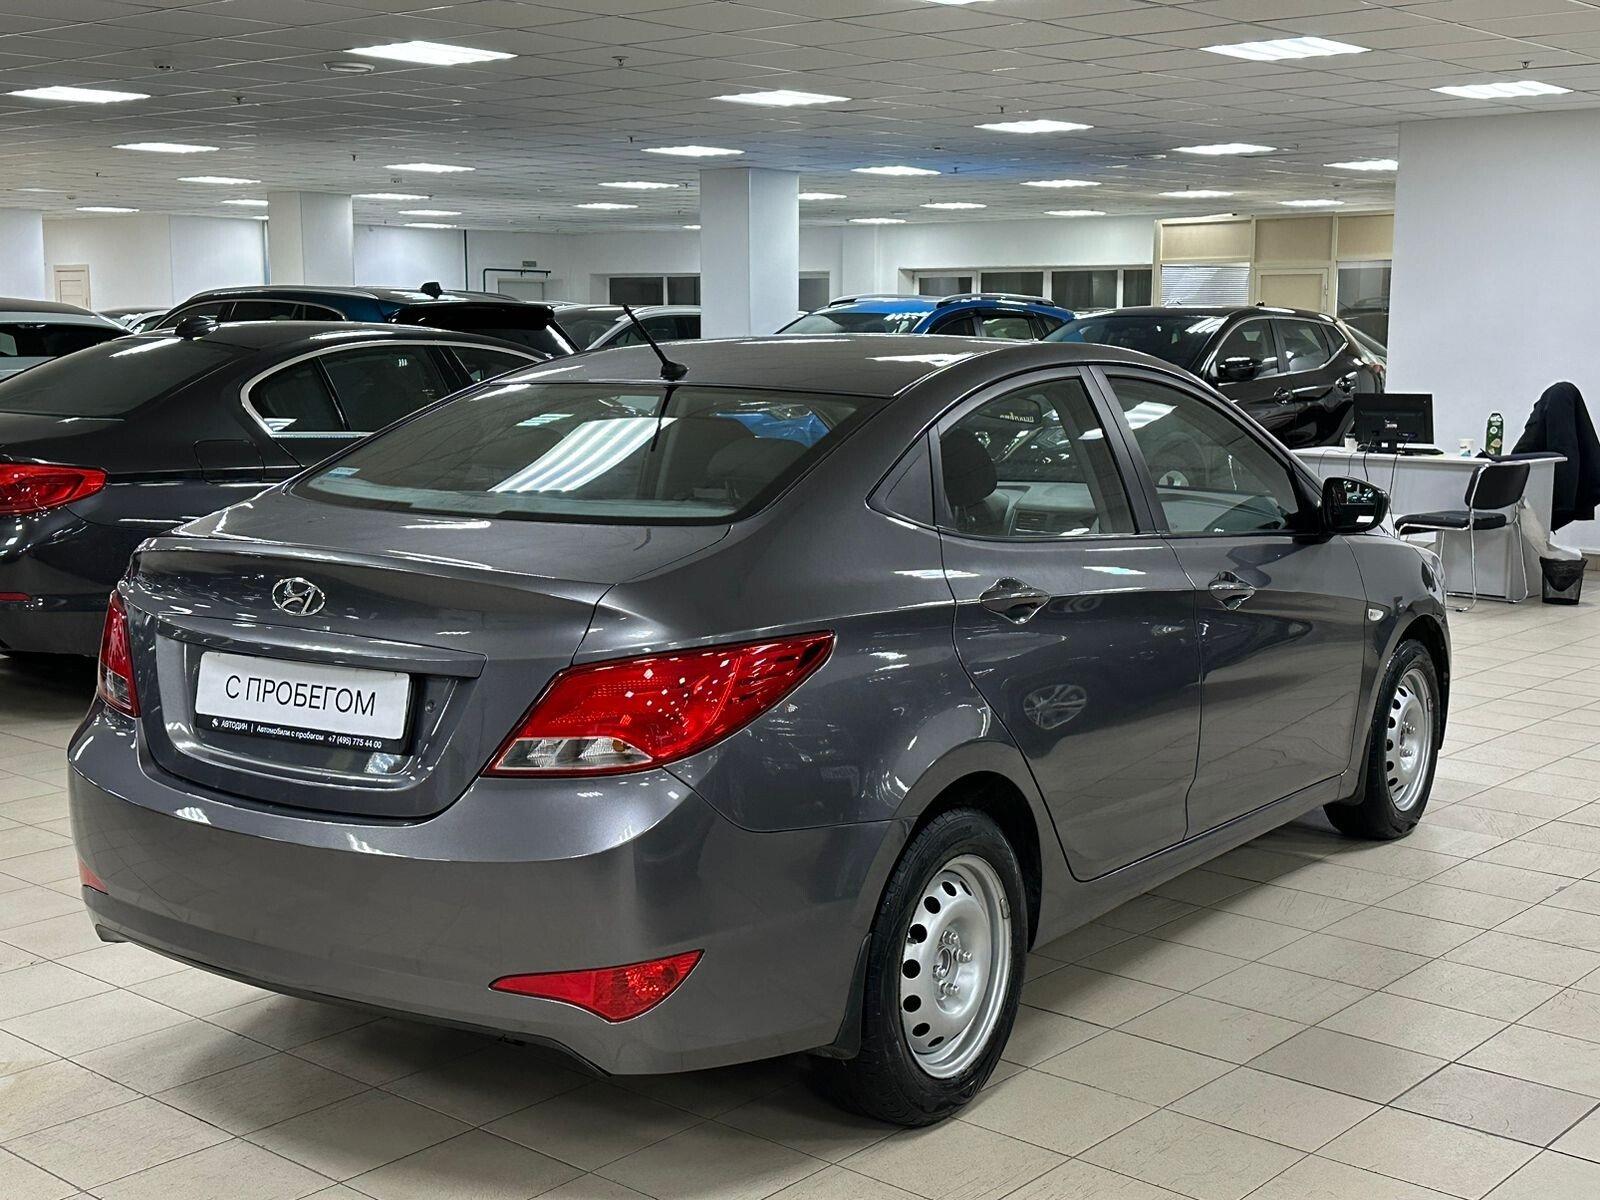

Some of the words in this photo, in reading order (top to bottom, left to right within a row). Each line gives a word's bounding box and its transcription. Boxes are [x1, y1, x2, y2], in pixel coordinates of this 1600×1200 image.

[226, 675, 241, 699] С
[245, 677, 376, 717] ПРОБЕГОМ
[220, 719, 248, 731] АВТОДИН
[256, 725, 291, 737] Автомобили
[295, 731, 324, 741] пробегом
[327, 735, 337, 743] +7
[337, 736, 352, 746] (495)
[352, 738, 364, 746] 775
[373, 741, 382, 749] 00
